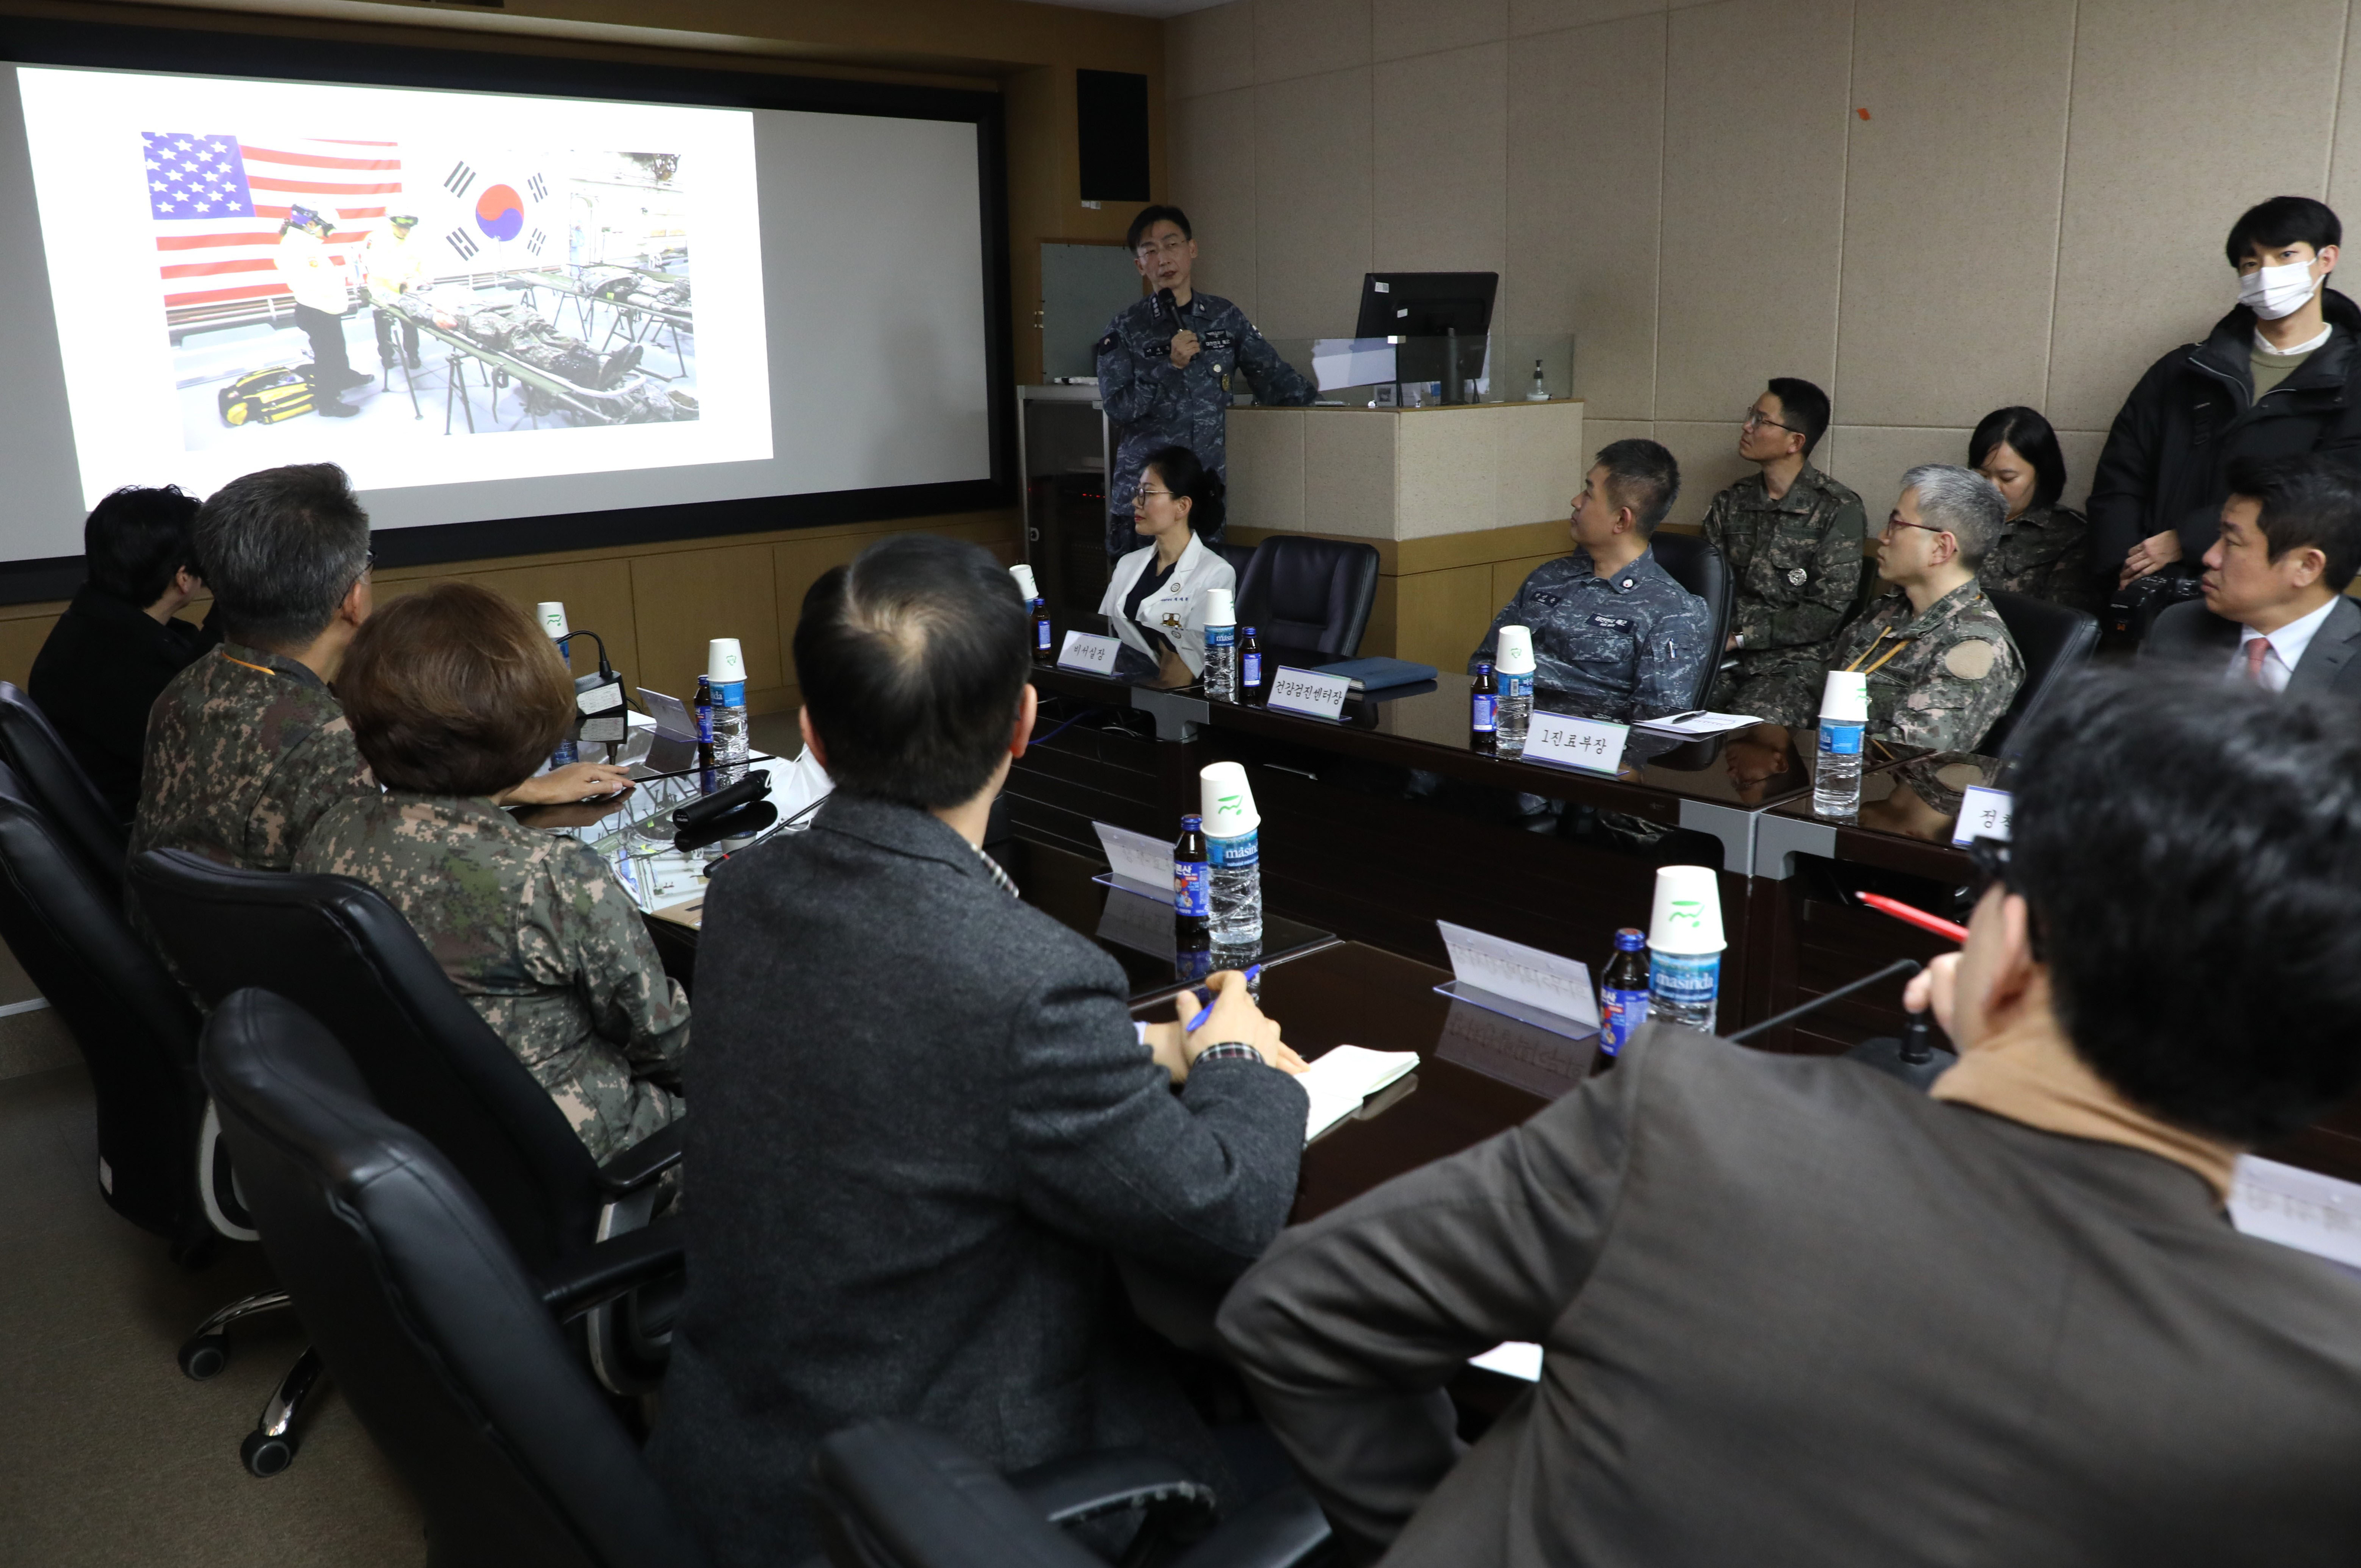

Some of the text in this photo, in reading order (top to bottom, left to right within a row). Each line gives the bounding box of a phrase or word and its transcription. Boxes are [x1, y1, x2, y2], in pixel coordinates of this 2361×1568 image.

[1074, 644, 1106, 661] 비서실장
[1275, 680, 1343, 705] 건강검진센터장
[1541, 729, 1607, 755] 1진료부장
[1656, 971, 1713, 990] masinda
